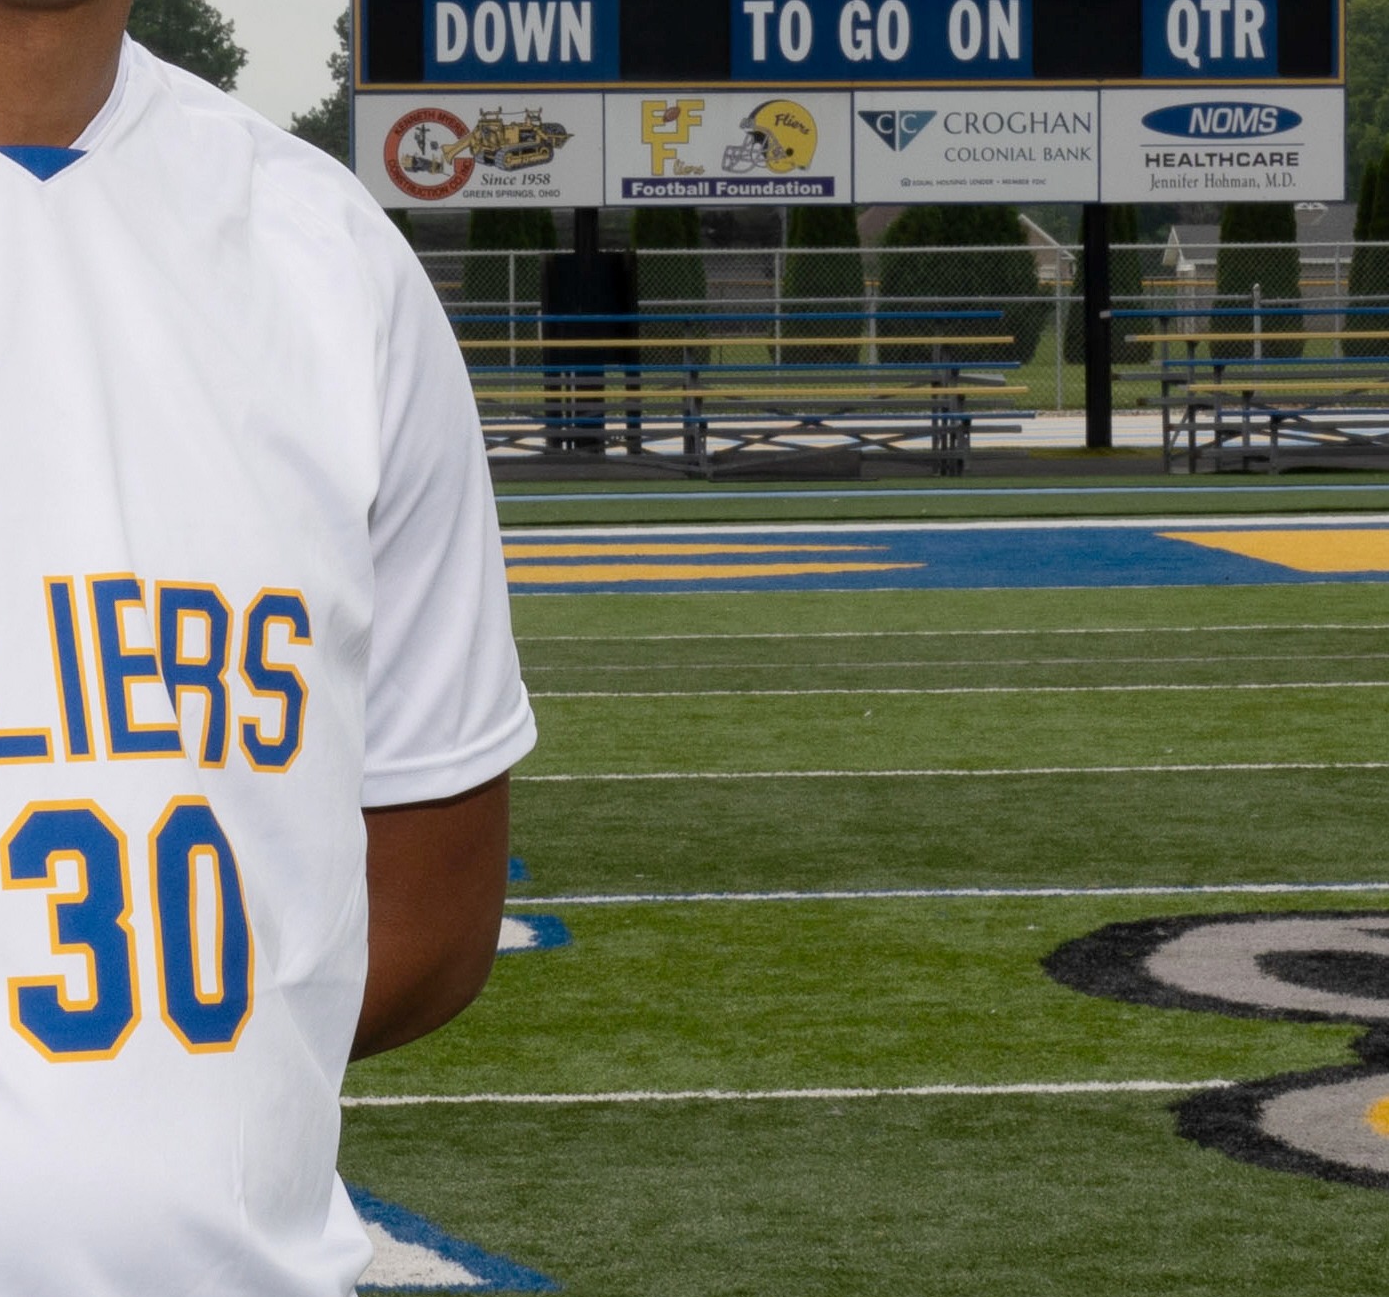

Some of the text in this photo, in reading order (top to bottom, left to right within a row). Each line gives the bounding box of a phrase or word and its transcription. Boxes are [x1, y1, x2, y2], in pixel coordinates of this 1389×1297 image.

[435, 0, 593, 64] DOWN
[743, 0, 815, 62] TO
[774, 113, 810, 136] Fliers
[943, 111, 1092, 135] CROGHAN
[1188, 107, 1279, 134] NOMS
[944, 147, 1093, 163] COLONIAL BANK
[1145, 152, 1300, 168] HEALTHCARE
[480, 173, 551, 186] Since 1958
[631, 180, 823, 197] Football Foundation
[1149, 172, 1297, 191] Jennifer Hohman, M.D.
[463, 189, 561, 200] GREEN SPRINGS, OHIO
